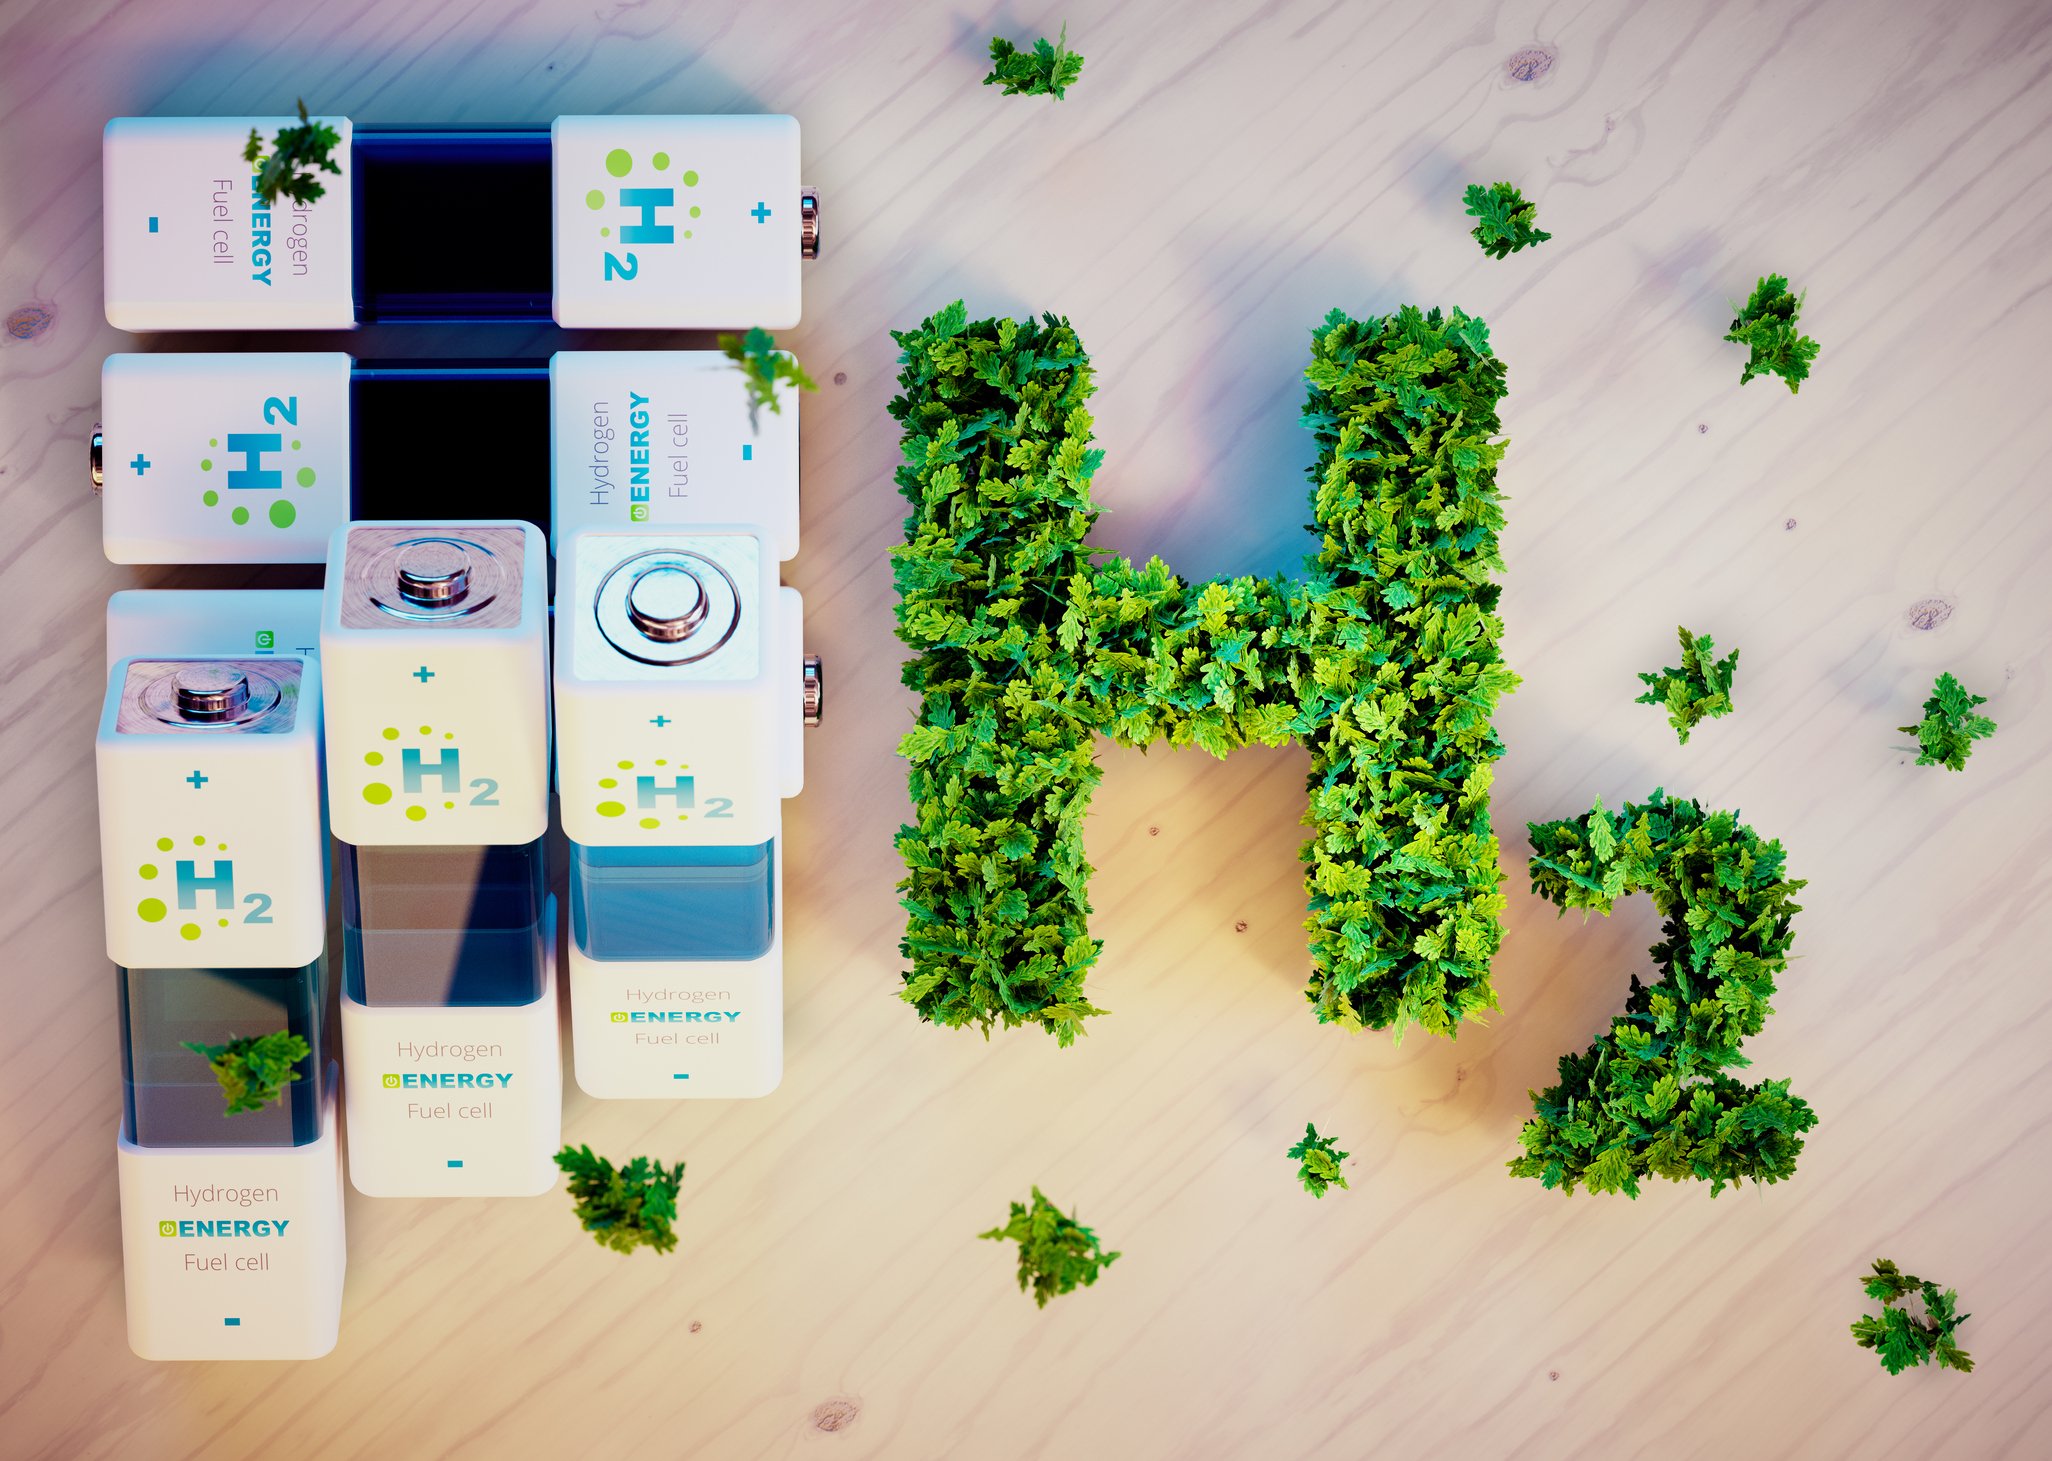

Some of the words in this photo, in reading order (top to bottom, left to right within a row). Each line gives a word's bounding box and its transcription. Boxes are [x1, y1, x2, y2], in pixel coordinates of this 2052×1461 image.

[213, 180, 233, 221] Fuel
[286, 173, 313, 275] drogen
[604, 188, 674, 281] H2
[213, 230, 234, 263] cell
[227, 396, 297, 489] H2
[630, 391, 650, 502] ENERGY
[667, 414, 688, 448] cell
[588, 401, 615, 505] Hydrogen
[667, 456, 688, 498] Fuel
[402, 748, 500, 806] H2
[636, 776, 734, 818] H2
[176, 860, 273, 924] H2
[626, 988, 731, 1005] Hydrogen
[630, 1011, 742, 1024] ENERGY
[397, 1041, 502, 1062] Hydrogen
[635, 1032, 678, 1045] Fuel
[686, 1032, 719, 1045] cell
[402, 1072, 514, 1089] ENERGY
[408, 1102, 451, 1119] Fuel
[458, 1102, 492, 1119] cell
[174, 1184, 279, 1207] Hydrogen
[178, 1220, 290, 1238] ENERGY
[184, 1253, 227, 1271] Fuel
[235, 1253, 269, 1271] cell
